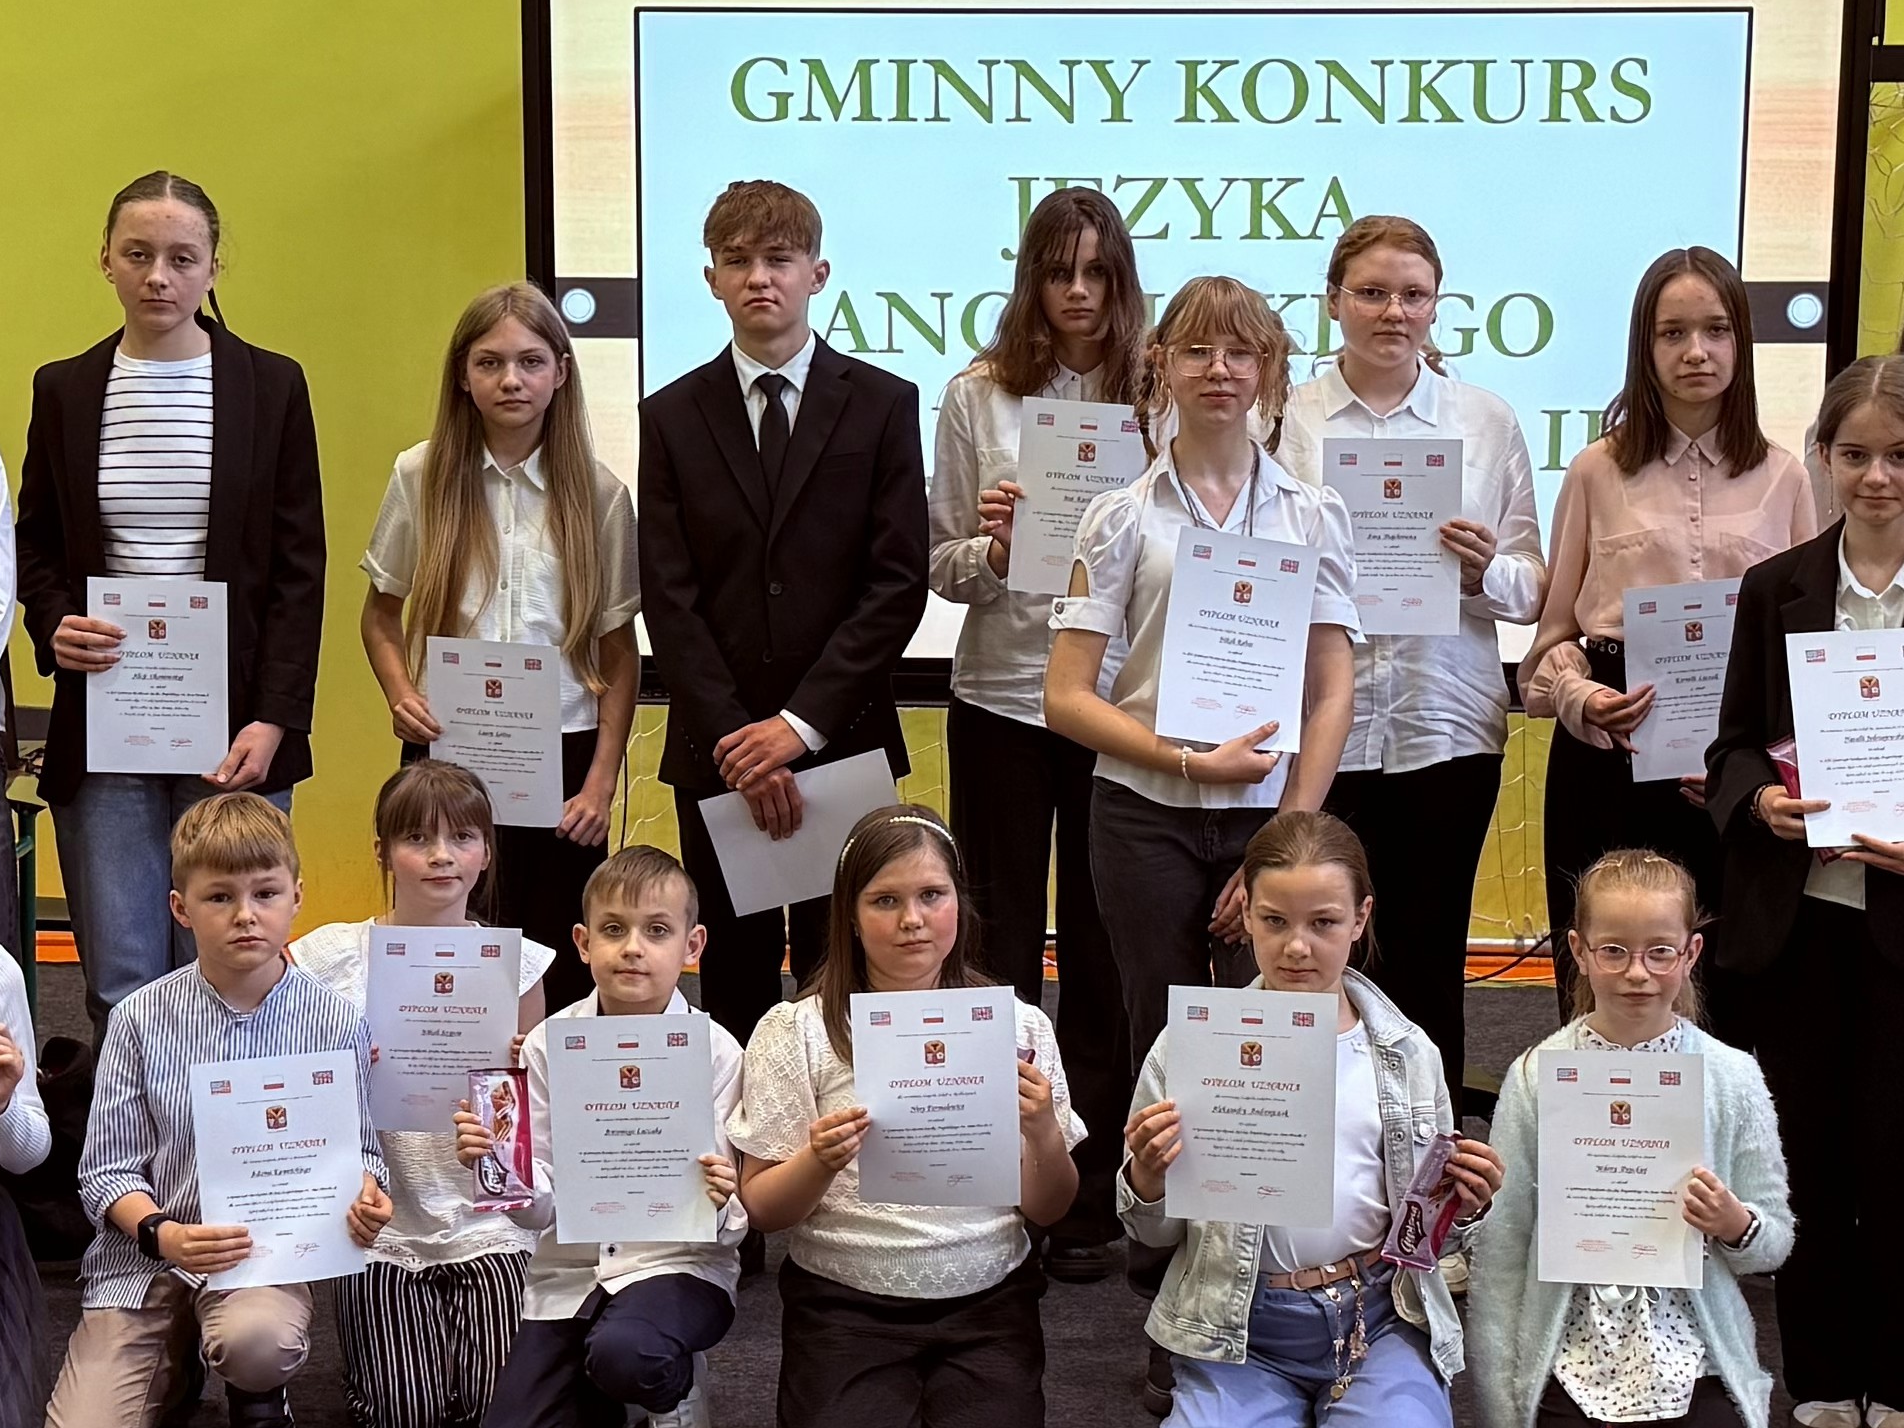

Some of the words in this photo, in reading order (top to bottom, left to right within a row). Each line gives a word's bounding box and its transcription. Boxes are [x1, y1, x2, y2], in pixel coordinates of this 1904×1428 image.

[730, 56, 1151, 124] GMINNY
[1174, 57, 1652, 123] KONKURS
[1001, 175, 1355, 261] JZYKA
